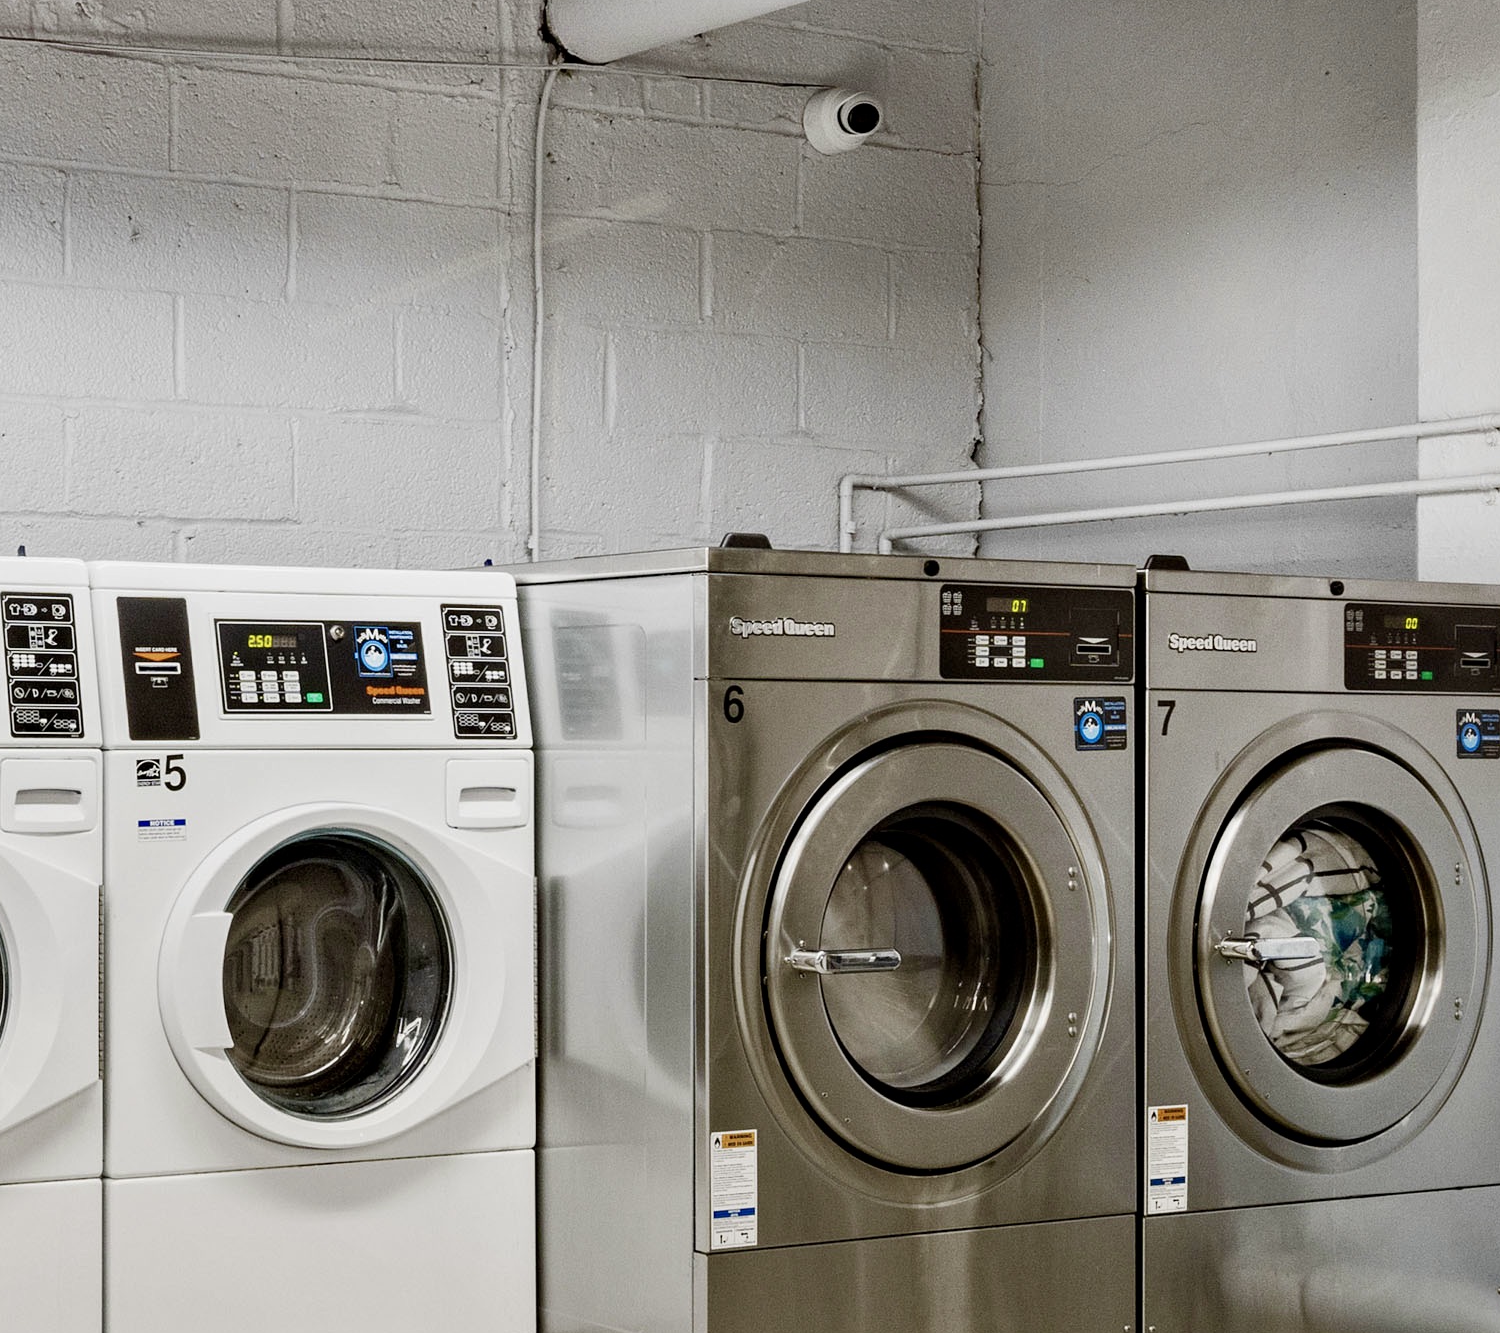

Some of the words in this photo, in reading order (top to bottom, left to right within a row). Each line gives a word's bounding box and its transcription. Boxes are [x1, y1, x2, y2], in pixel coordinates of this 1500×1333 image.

[1011, 599, 1027, 612] 07
[730, 617, 783, 638] Speed
[784, 618, 835, 636] Queen
[1169, 633, 1213, 652] Speed
[1214, 634, 1257, 651] Queen
[723, 684, 744, 724] 6
[1157, 700, 1176, 736] 7
[164, 754, 187, 791] 5
